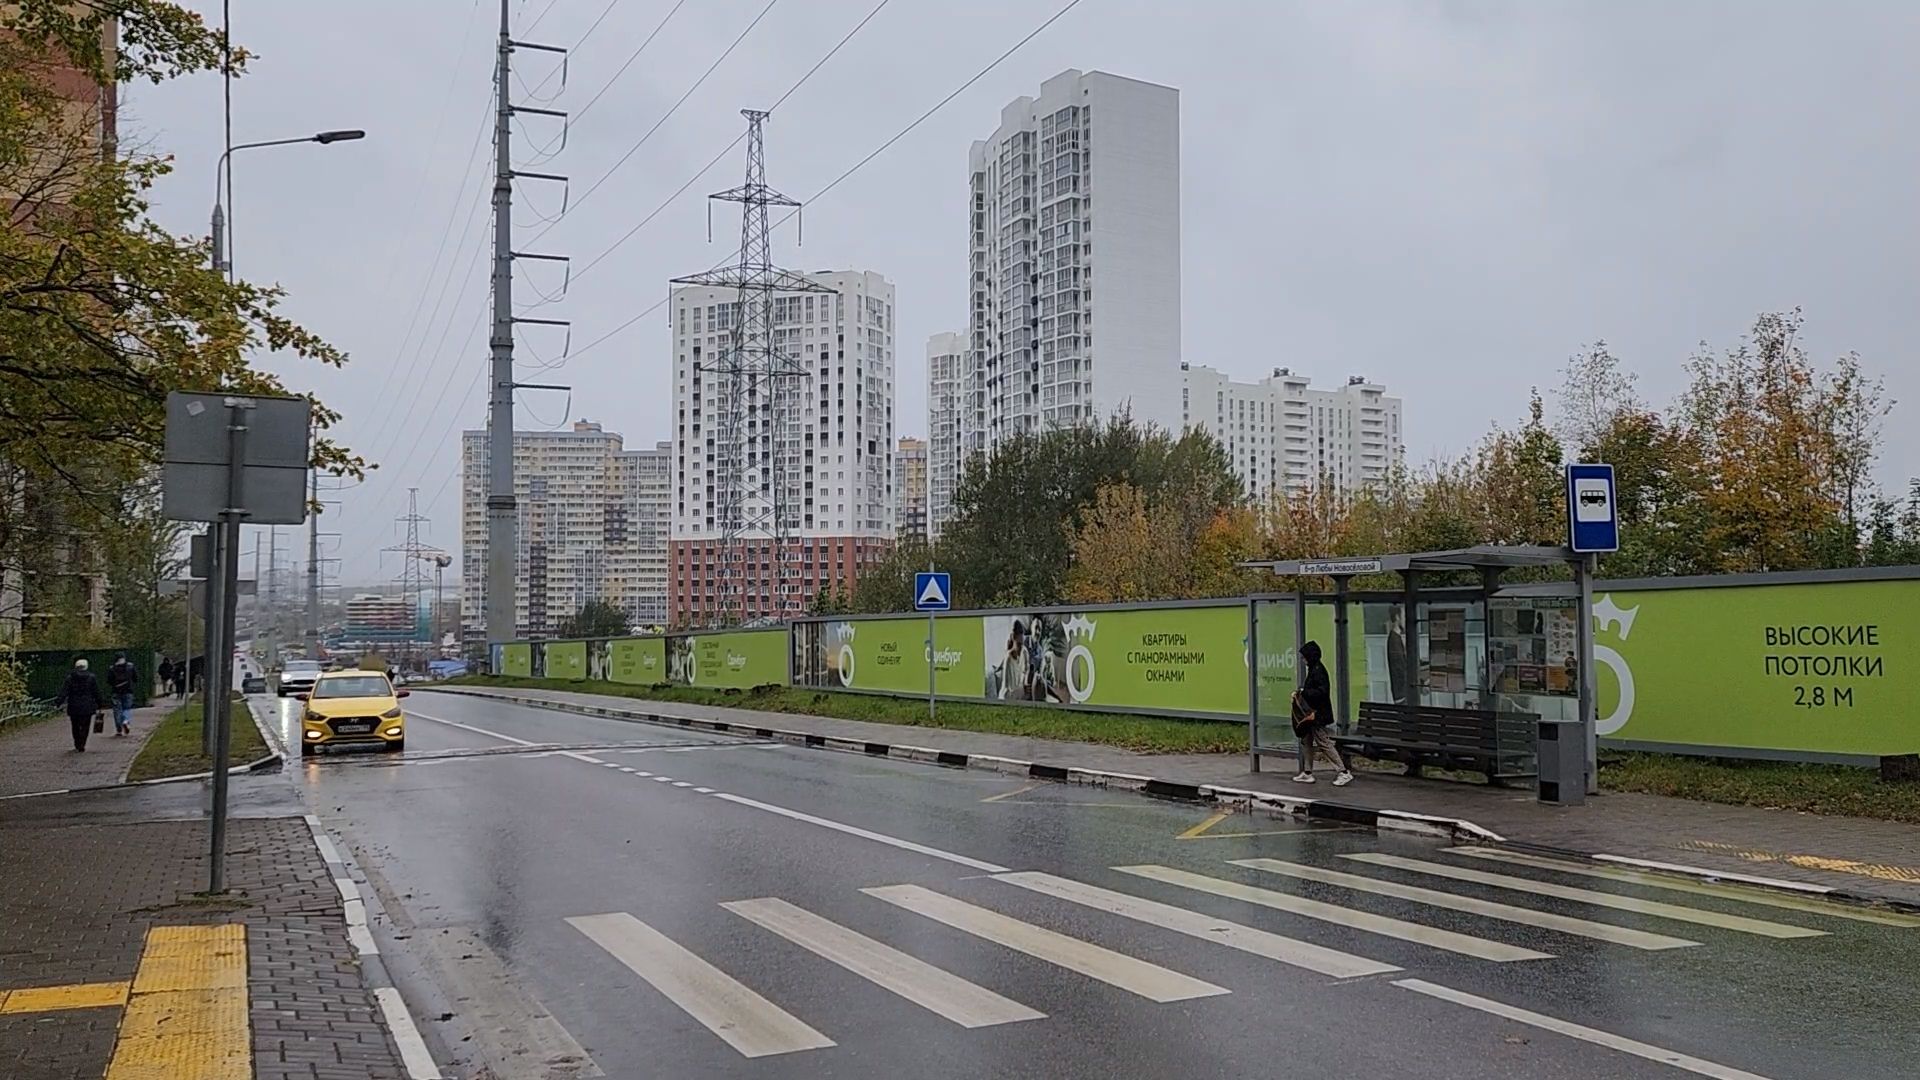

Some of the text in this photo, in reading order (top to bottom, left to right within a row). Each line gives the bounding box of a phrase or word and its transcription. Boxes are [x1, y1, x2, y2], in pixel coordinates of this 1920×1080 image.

[1142, 633, 1187, 646] КВАРТИРЫ
[1765, 625, 1880, 646] ВЫСОКИЕ
[1126, 651, 1205, 664] С ПАНОРАМНЫМИ
[1765, 656, 1883, 677] ПОТОЛКИ
[1145, 669, 1185, 682] ОКНАМИ
[1794, 686, 1853, 709] 2,8 М
